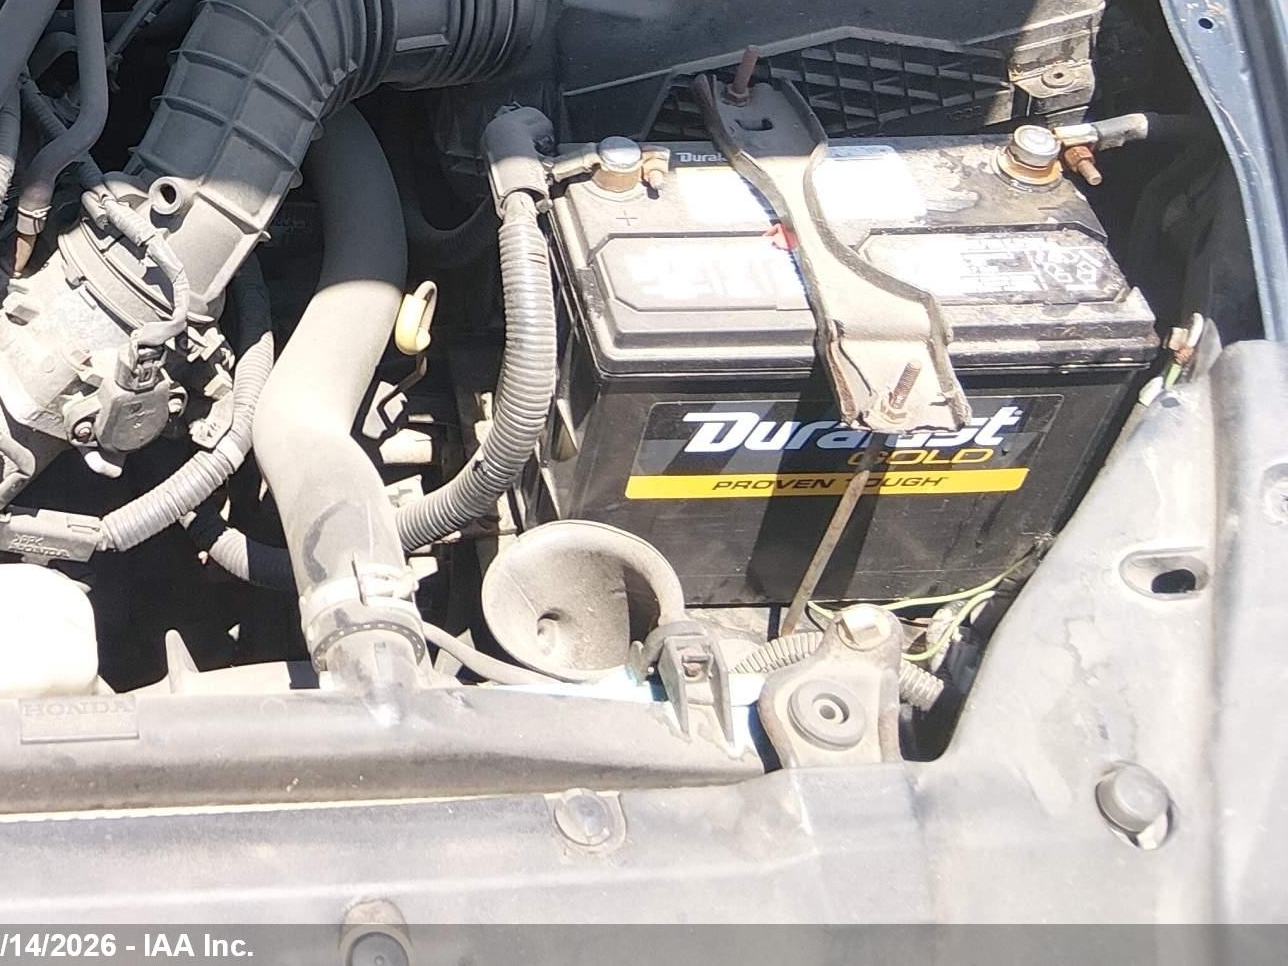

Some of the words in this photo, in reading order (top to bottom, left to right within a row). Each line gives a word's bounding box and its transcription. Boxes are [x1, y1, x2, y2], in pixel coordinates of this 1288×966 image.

[674, 151, 728, 163] Dural
[712, 478, 836, 491] PROVEN
[23, 699, 136, 718] HONDA
